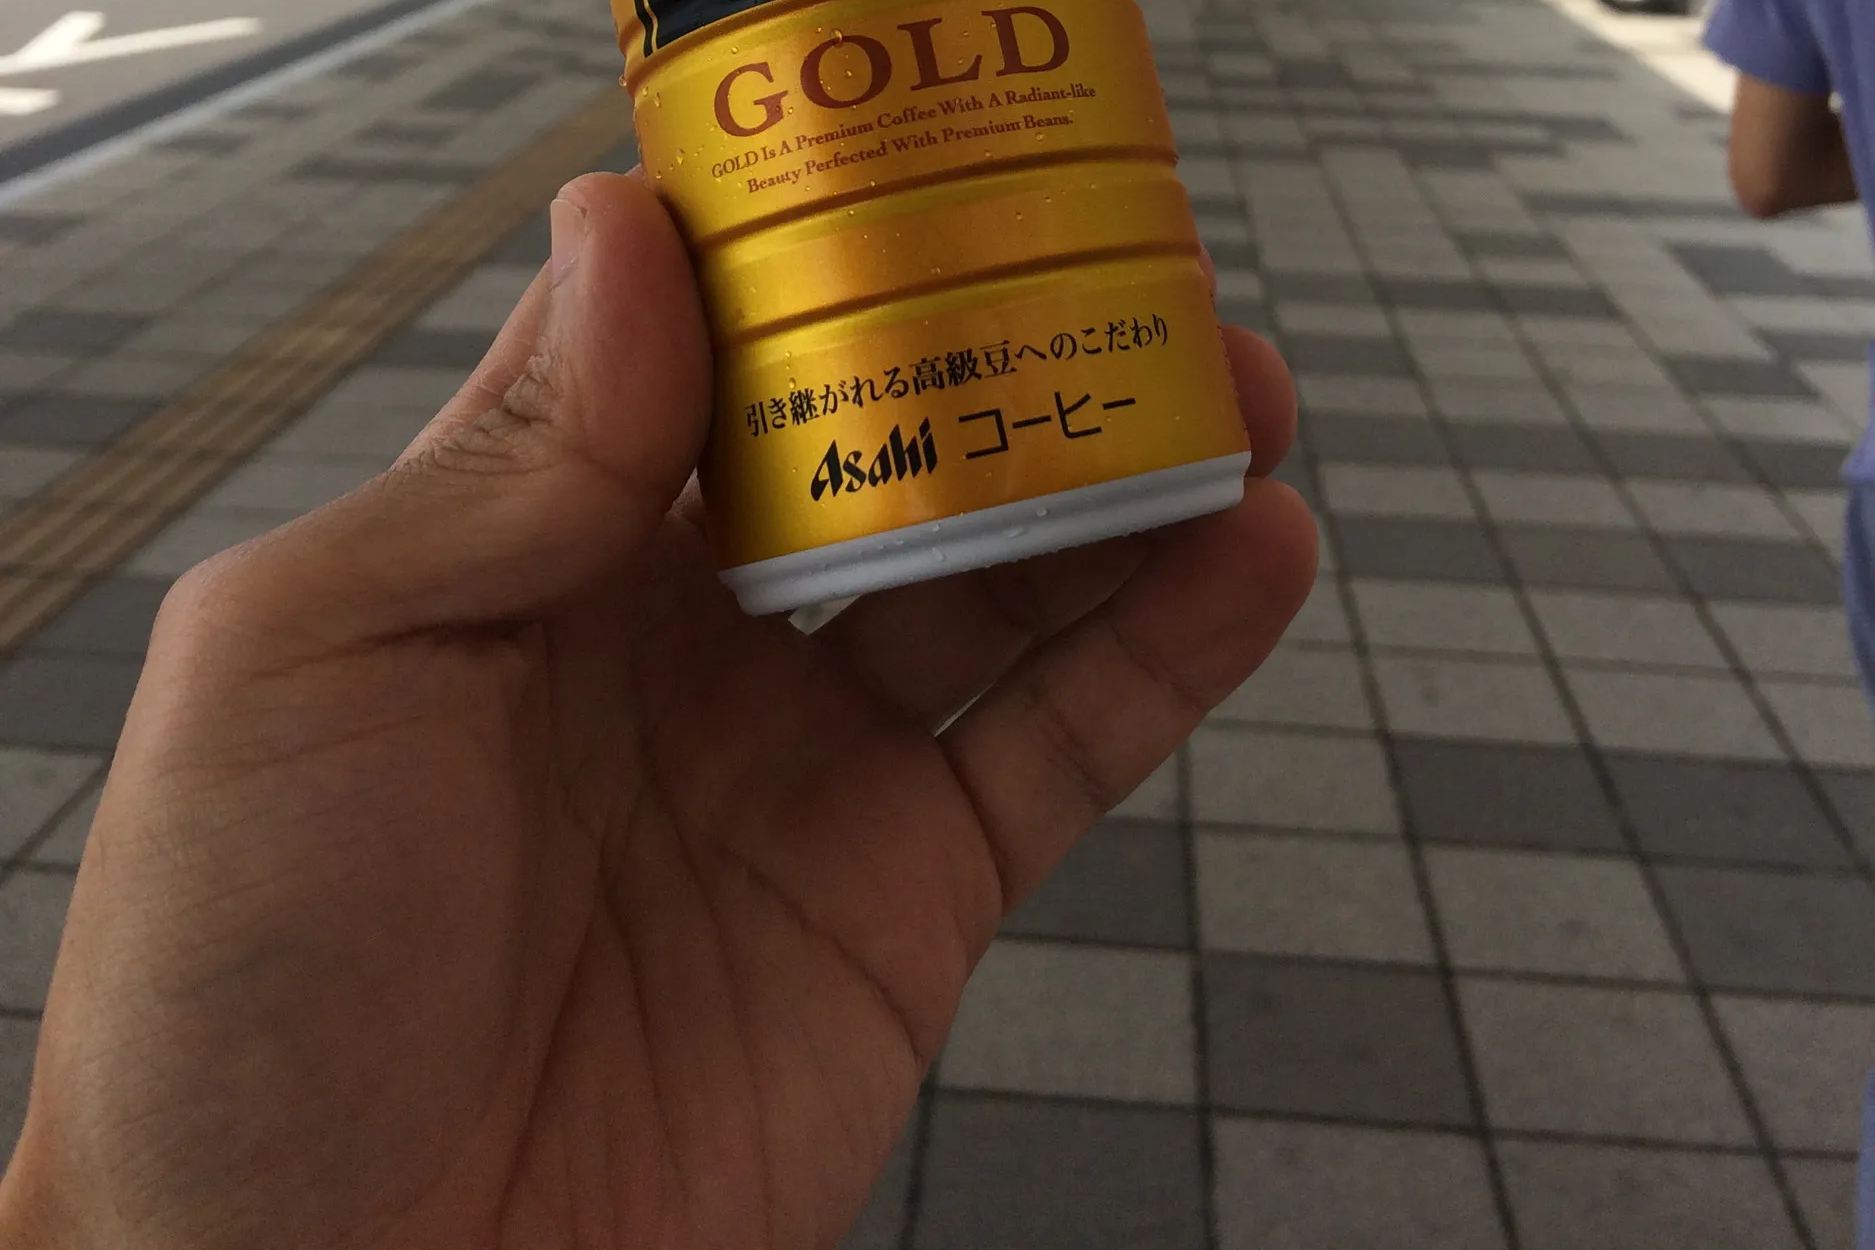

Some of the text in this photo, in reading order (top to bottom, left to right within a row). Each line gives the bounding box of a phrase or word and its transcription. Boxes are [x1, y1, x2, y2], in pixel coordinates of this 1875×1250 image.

[714, 6, 1070, 137] GOLD
[711, 83, 1096, 179] GOLD Is A Premium Coffee With A Radiant-like
[747, 113, 1074, 194] Beauty Perfected With Premium Beans.
[745, 313, 1168, 437] 引き継がれる高級豆へのこだわり
[811, 391, 1136, 502] Asahi コーヒー
